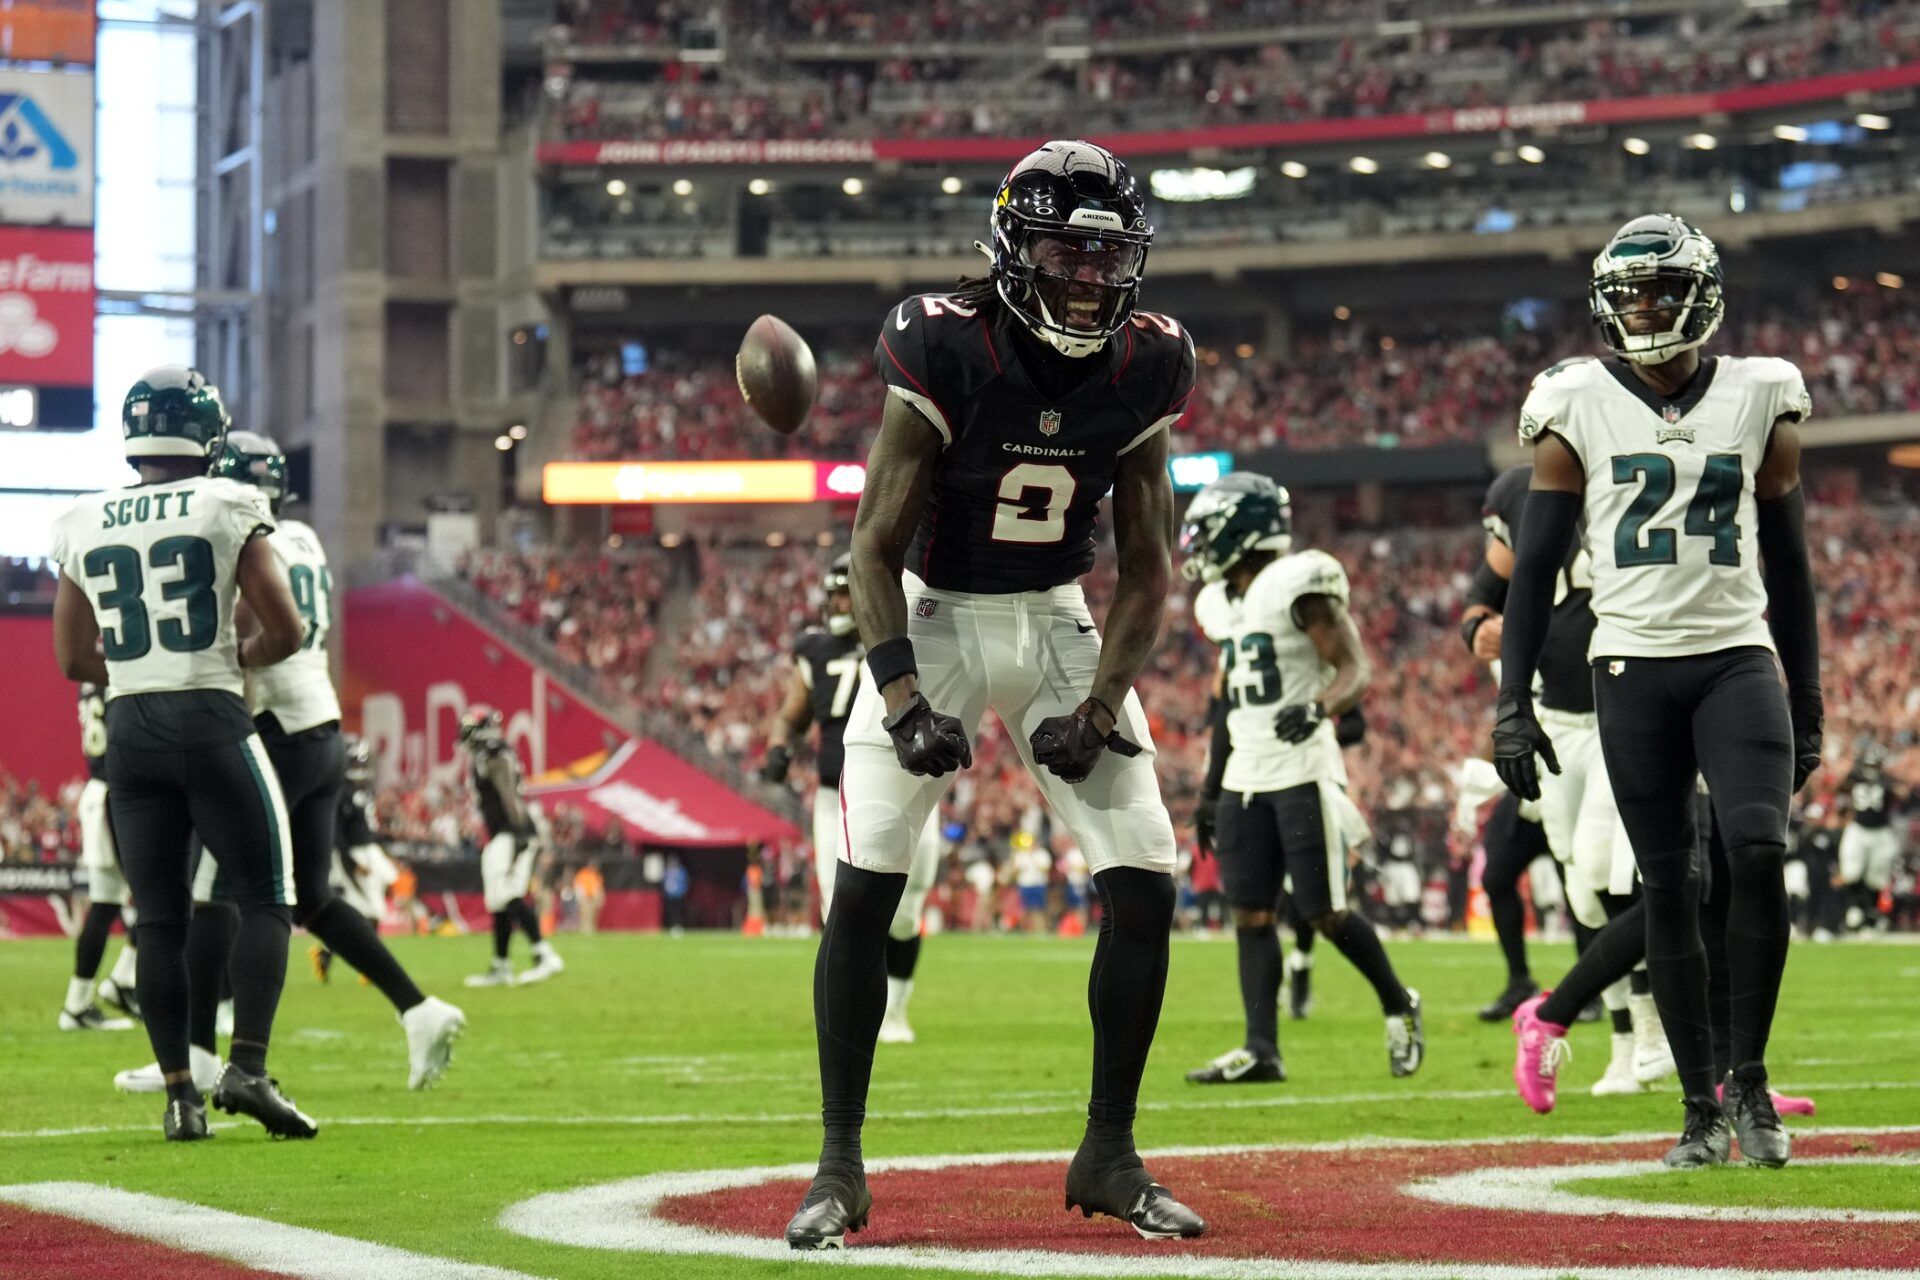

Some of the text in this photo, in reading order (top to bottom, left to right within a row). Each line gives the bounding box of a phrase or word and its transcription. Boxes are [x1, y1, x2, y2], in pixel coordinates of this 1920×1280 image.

[596, 139, 661, 164] JOHN
[1081, 213, 1115, 222] ARIZONA
[1001, 442, 1087, 457] CARDINALS
[103, 489, 196, 529] SCOTT
[991, 462, 1077, 543] 2
[1611, 453, 1744, 569] 24
[83, 535, 218, 662] 33
[826, 658, 866, 718] 7
